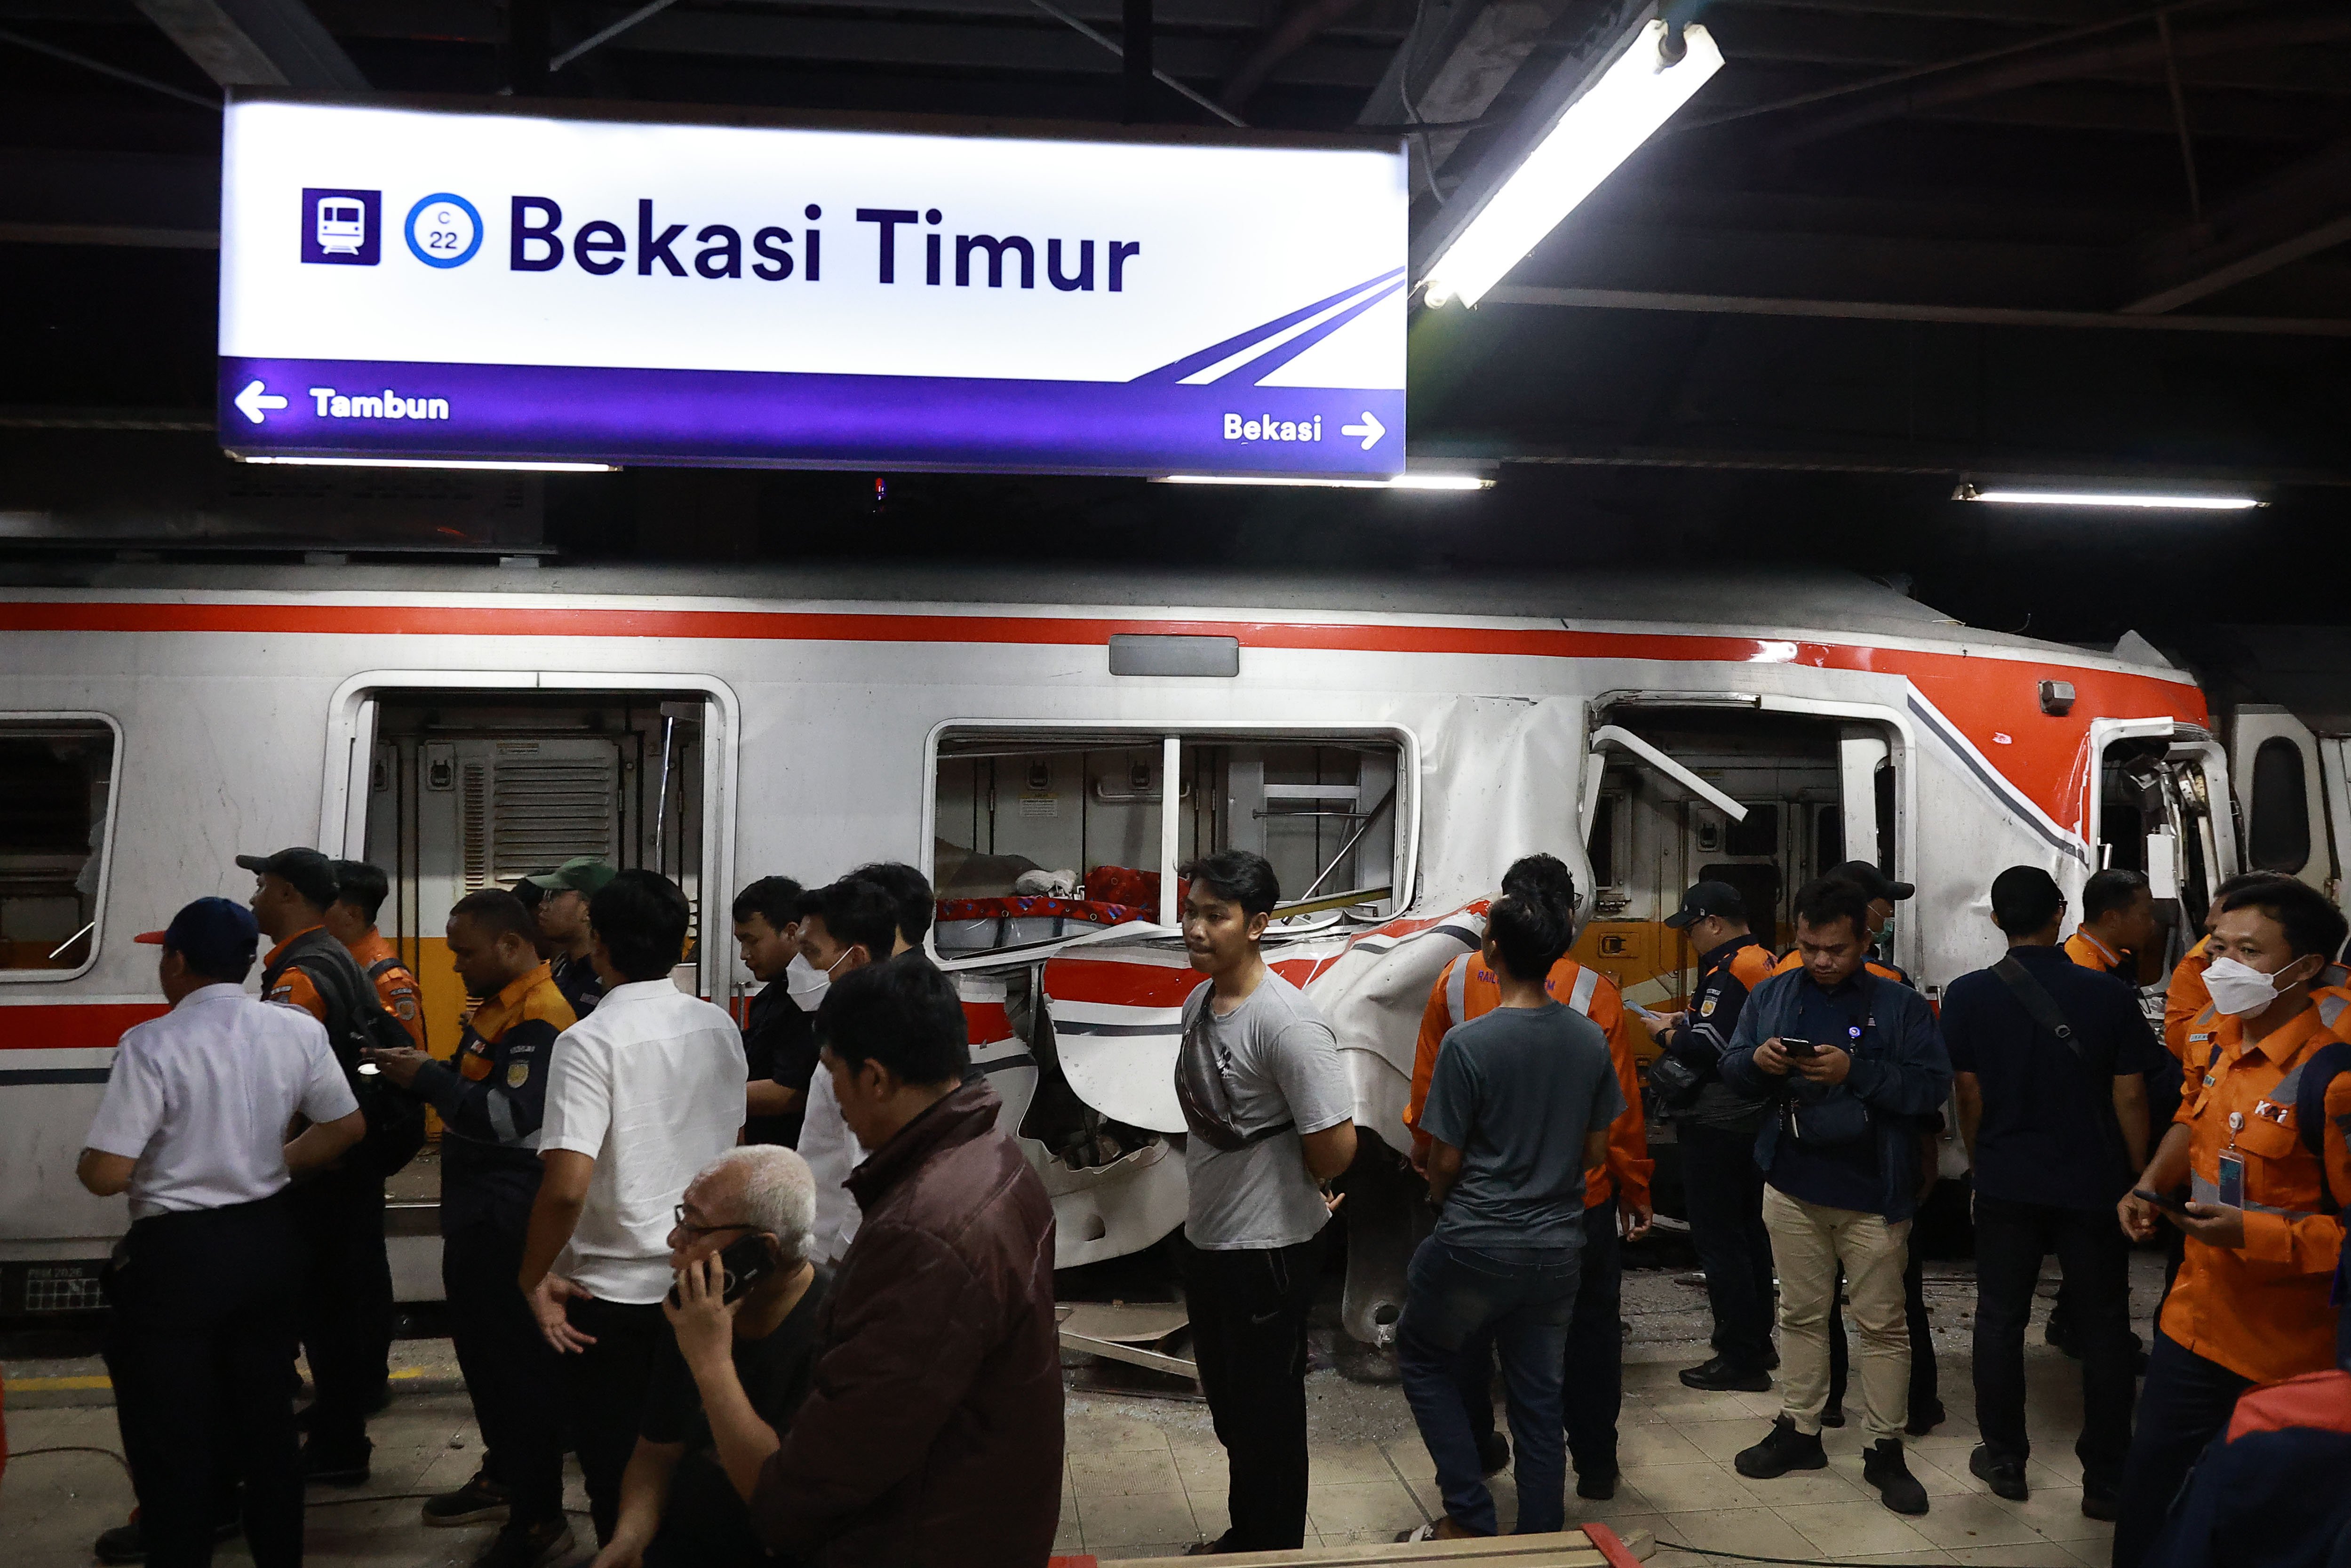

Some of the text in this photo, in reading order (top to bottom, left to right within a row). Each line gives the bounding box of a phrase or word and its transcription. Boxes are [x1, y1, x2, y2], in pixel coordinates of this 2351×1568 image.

[438, 211, 451, 224] C
[430, 231, 457, 249] 22
[510, 195, 1140, 293] Bekasi Timur
[309, 387, 449, 420] Tambun
[1224, 413, 1322, 442] Bekasi
